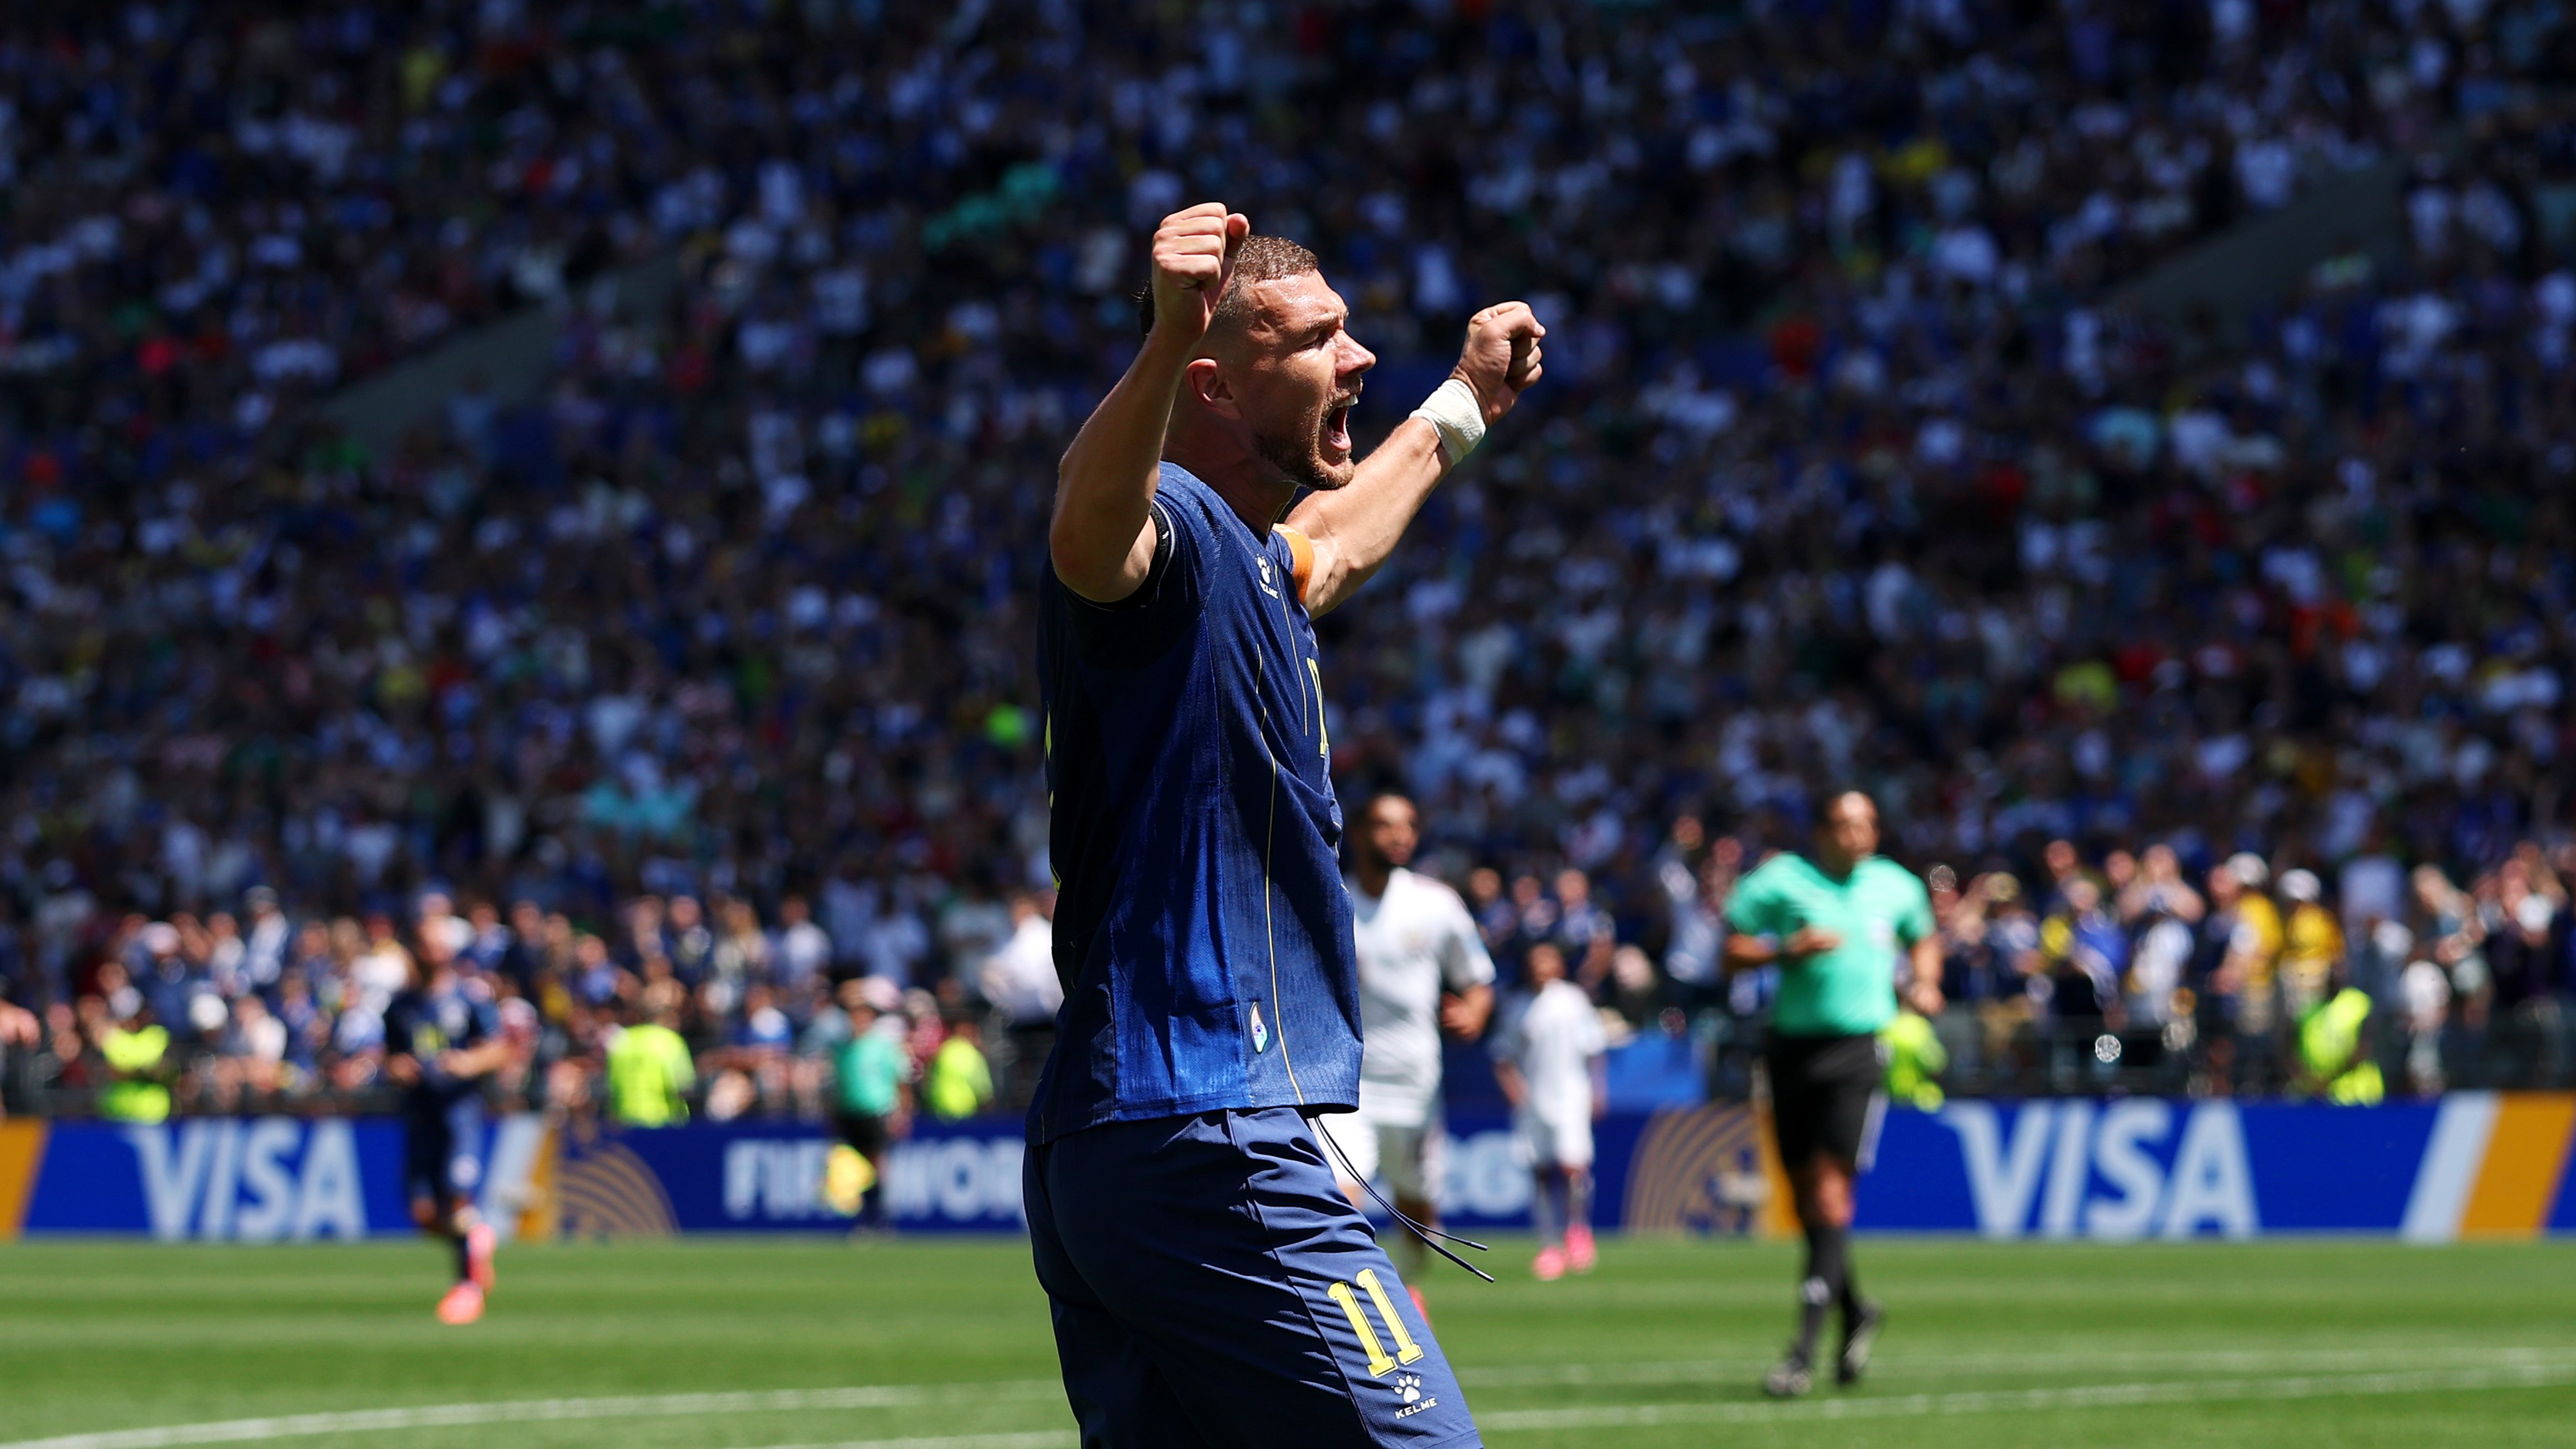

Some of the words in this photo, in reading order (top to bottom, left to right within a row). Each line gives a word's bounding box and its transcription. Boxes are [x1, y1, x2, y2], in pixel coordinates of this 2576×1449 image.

[125, 1118, 370, 1240] VISA
[1940, 1097, 2263, 1240] VISA
[1327, 1268, 1424, 1378] 11
[1394, 1397, 1437, 1419] KELME
